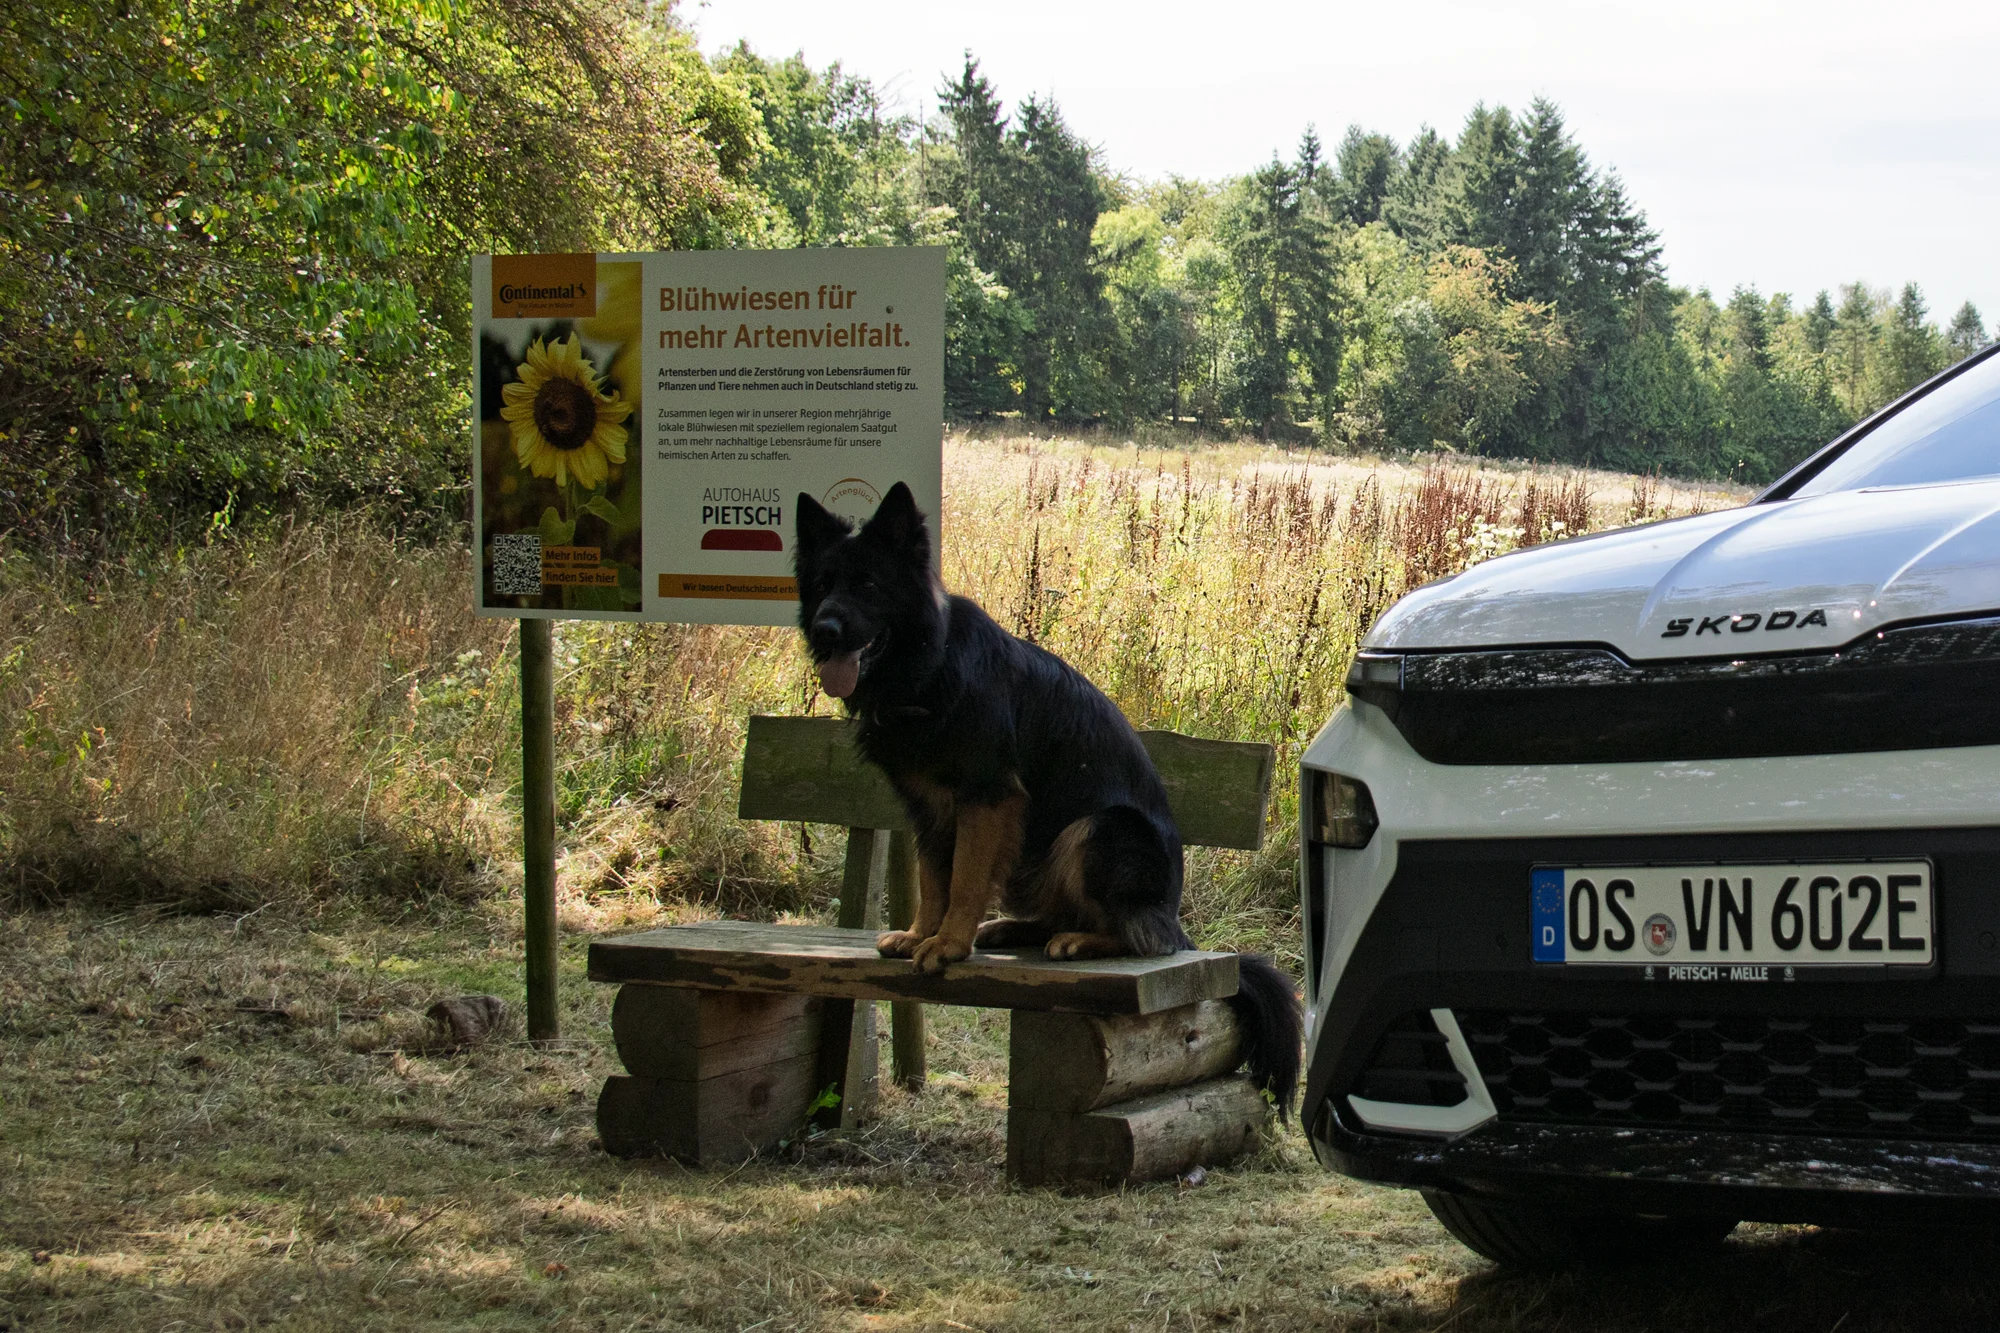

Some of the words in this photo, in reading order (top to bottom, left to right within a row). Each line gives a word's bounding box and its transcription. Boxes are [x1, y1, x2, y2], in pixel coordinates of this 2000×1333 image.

[500, 284, 574, 304] Continental
[660, 286, 809, 311] Blühwiesen
[818, 285, 857, 309] für
[660, 324, 727, 348] mehr
[734, 322, 910, 348] Artenvielfalt.
[659, 368, 717, 377] Artensterben
[719, 368, 736, 376] und
[738, 368, 752, 376] die
[754, 367, 804, 378] Zerstörung
[826, 367, 894, 376] Lebensräumen
[897, 367, 911, 376] für
[659, 382, 696, 391] Pflanzen
[699, 382, 716, 391] und
[718, 382, 740, 391] Tiere
[743, 382, 779, 391] nehmen
[781, 382, 803, 390] auch
[806, 382, 813, 390] in
[816, 382, 873, 390] Deutschland
[876, 382, 902, 392] stetig
[658, 409, 707, 418] Zusammen
[709, 409, 734, 419] legen
[737, 409, 750, 417] wir
[753, 409, 761, 417] in
[800, 409, 832, 419] Region
[835, 409, 891, 419] mehrjährige
[659, 423, 684, 432] lokale
[687, 423, 737, 432] Blühwiesen
[740, 423, 754, 432] mit
[757, 423, 804, 434] speziellem
[807, 423, 859, 434] regionalem
[861, 423, 897, 434] Saatgut
[659, 439, 671, 447] an,
[690, 438, 713, 446] mehr
[716, 437, 768, 448] nachhaltige
[770, 437, 832, 446] Lebensräume
[834, 437, 847, 446] für
[659, 451, 708, 460] heimischen
[711, 451, 735, 460] Arten
[751, 451, 791, 460] schaffen.
[703, 488, 780, 502] AUTOHAUS
[831, 488, 874, 504] Artenglück
[703, 506, 781, 525] PIETSCH
[546, 551, 570, 560] Mehr
[574, 551, 597, 560] Infos
[546, 572, 576, 582] finden
[580, 572, 594, 582] Sie
[596, 572, 616, 582] hier
[683, 583, 696, 591] Wir
[726, 584, 777, 593] Deutschland
[1661, 609, 1827, 638] SKODA
[1568, 877, 1635, 952] OS
[1682, 877, 1752, 952] VN
[1770, 874, 1926, 952] 602E
[1542, 926, 1555, 946] D
[1668, 966, 1717, 980] PIETSCH
[1731, 967, 1768, 980] MELLE
